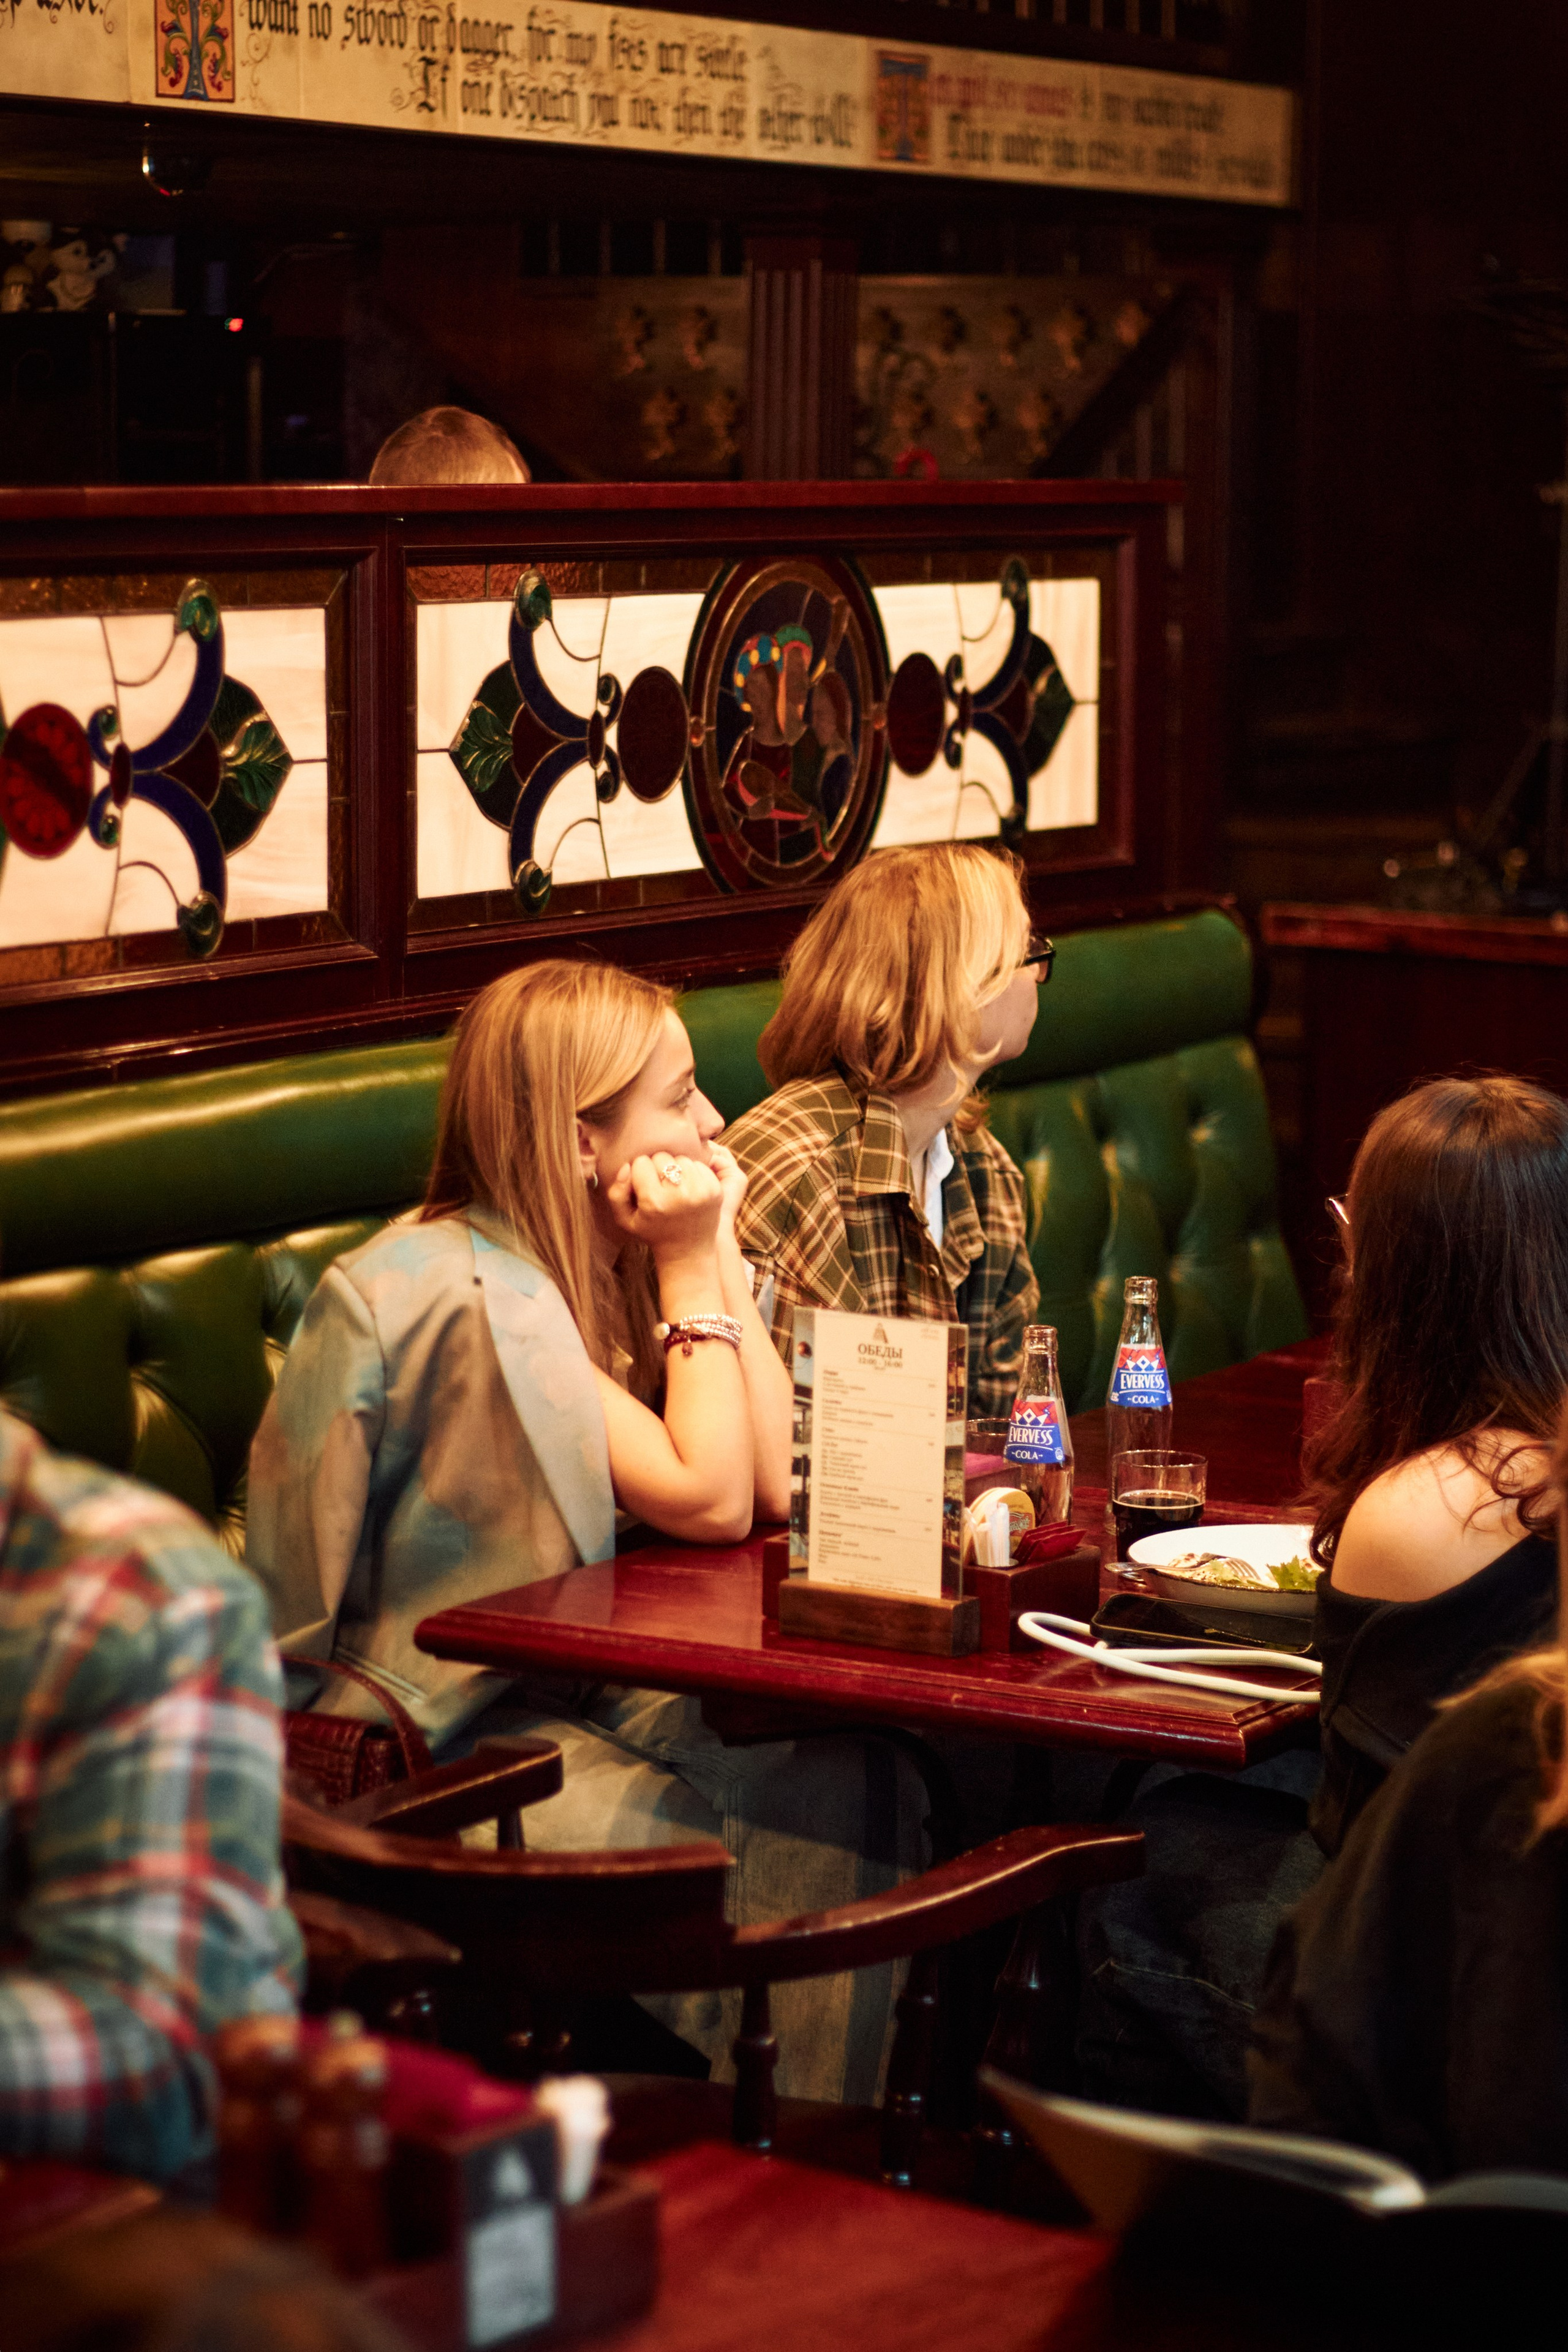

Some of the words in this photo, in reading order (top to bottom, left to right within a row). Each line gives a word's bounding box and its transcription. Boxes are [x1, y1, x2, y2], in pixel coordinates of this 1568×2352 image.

[308, 2, 332, 40] no
[341, 0, 408, 51] sword
[418, 14, 440, 53] or
[858, 1343, 903, 1359] ОБЕДЫ
[1120, 1373, 1165, 1390] EVERVESS
[1132, 1395, 1156, 1404] COLA
[1009, 1426, 1053, 1446] EVERVESS
[1015, 1450, 1039, 1460] COLA
